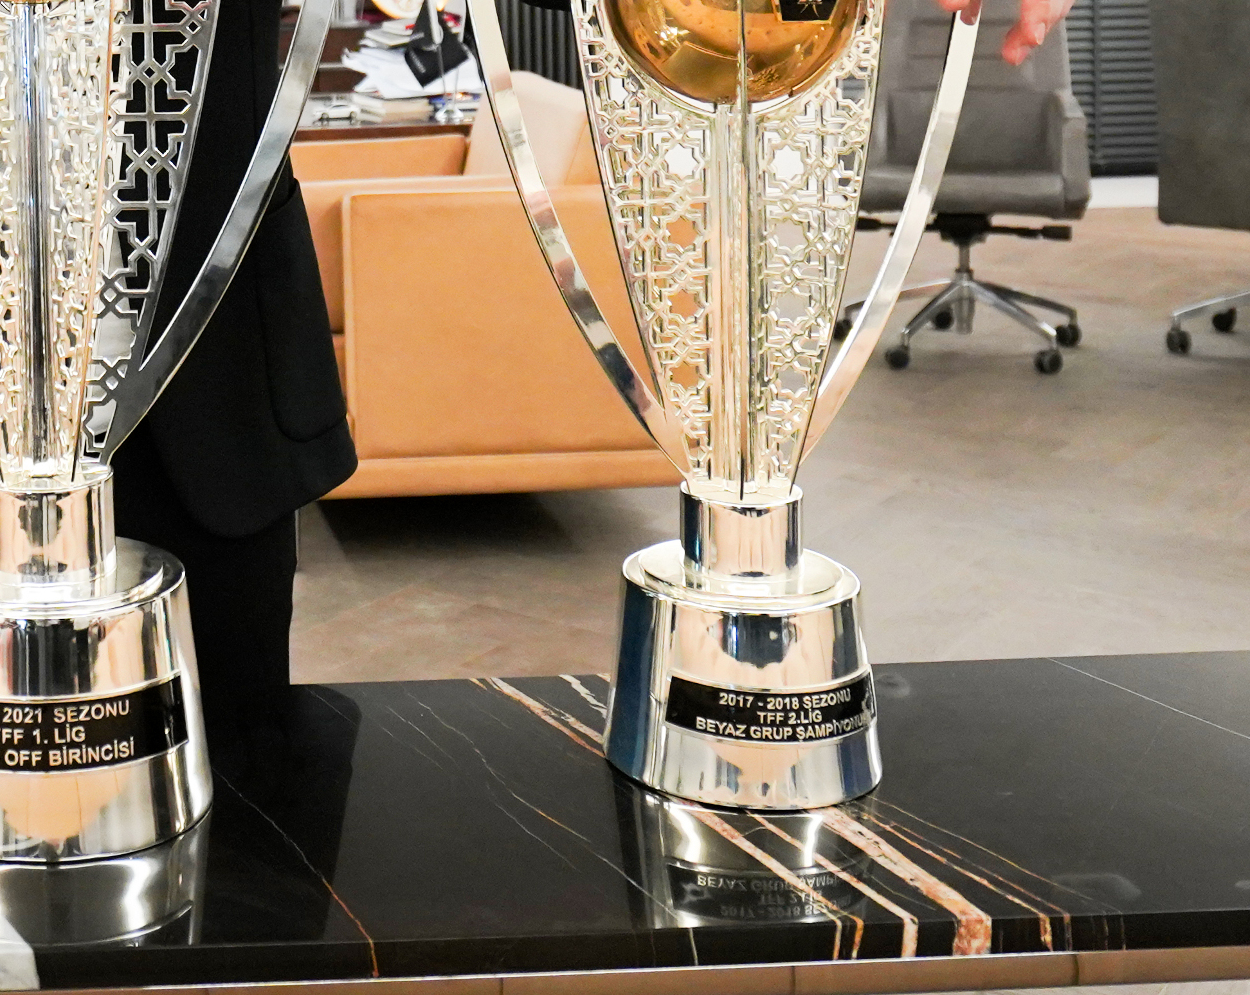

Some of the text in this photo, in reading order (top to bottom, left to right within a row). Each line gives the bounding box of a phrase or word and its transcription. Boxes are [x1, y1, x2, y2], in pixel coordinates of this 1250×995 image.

[718, 692, 753, 708] 2017
[767, 697, 799, 710] 2018
[802, 688, 851, 710] SEZONU
[2, 707, 43, 724] 2021
[53, 699, 130, 723] SEZONU
[757, 711, 784, 725] TFF
[32, 728, 48, 745] 1.
[54, 723, 86, 744] LİG
[696, 716, 747, 738] BEYAZ
[750, 726, 793, 740] GRUP
[4, 749, 43, 767] OFF
[48, 736, 135, 767] BİRİNCİSİ
